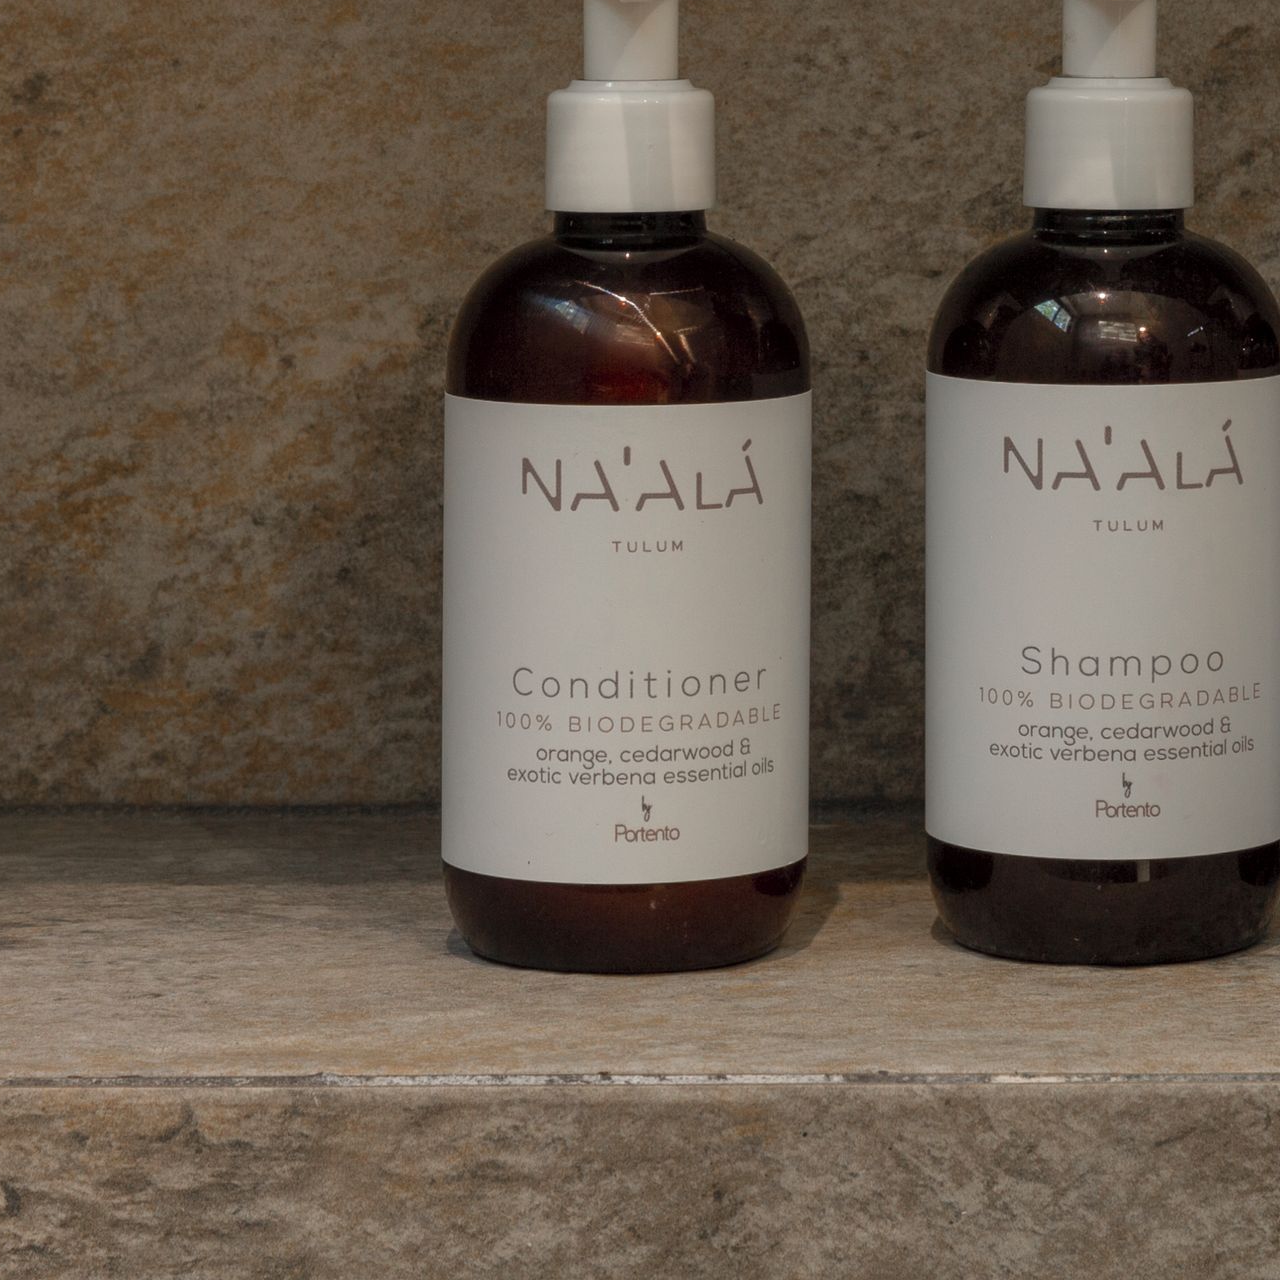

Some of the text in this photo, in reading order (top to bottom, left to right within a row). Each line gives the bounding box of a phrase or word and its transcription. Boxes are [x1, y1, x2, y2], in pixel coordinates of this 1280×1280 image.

[1093, 519, 1165, 532] TULUM
[611, 540, 684, 554] TULUM
[1021, 645, 1225, 683] Shampoo
[512, 666, 767, 700] Conditioner
[979, 682, 1262, 710] 100% BIODEGRADABLE
[496, 703, 782, 733] 100% BIODEGRADABLE
[1017, 716, 1231, 746] orange, cedarwood &
[536, 738, 751, 770] orange, cedarwood &
[989, 736, 1254, 762] exotic verbena essential oils
[507, 757, 774, 786] exotic verbena essential oils
[1122, 772, 1132, 798] by
[641, 795, 652, 822] by
[1095, 799, 1161, 819] Portento
[614, 824, 680, 843] Portento
